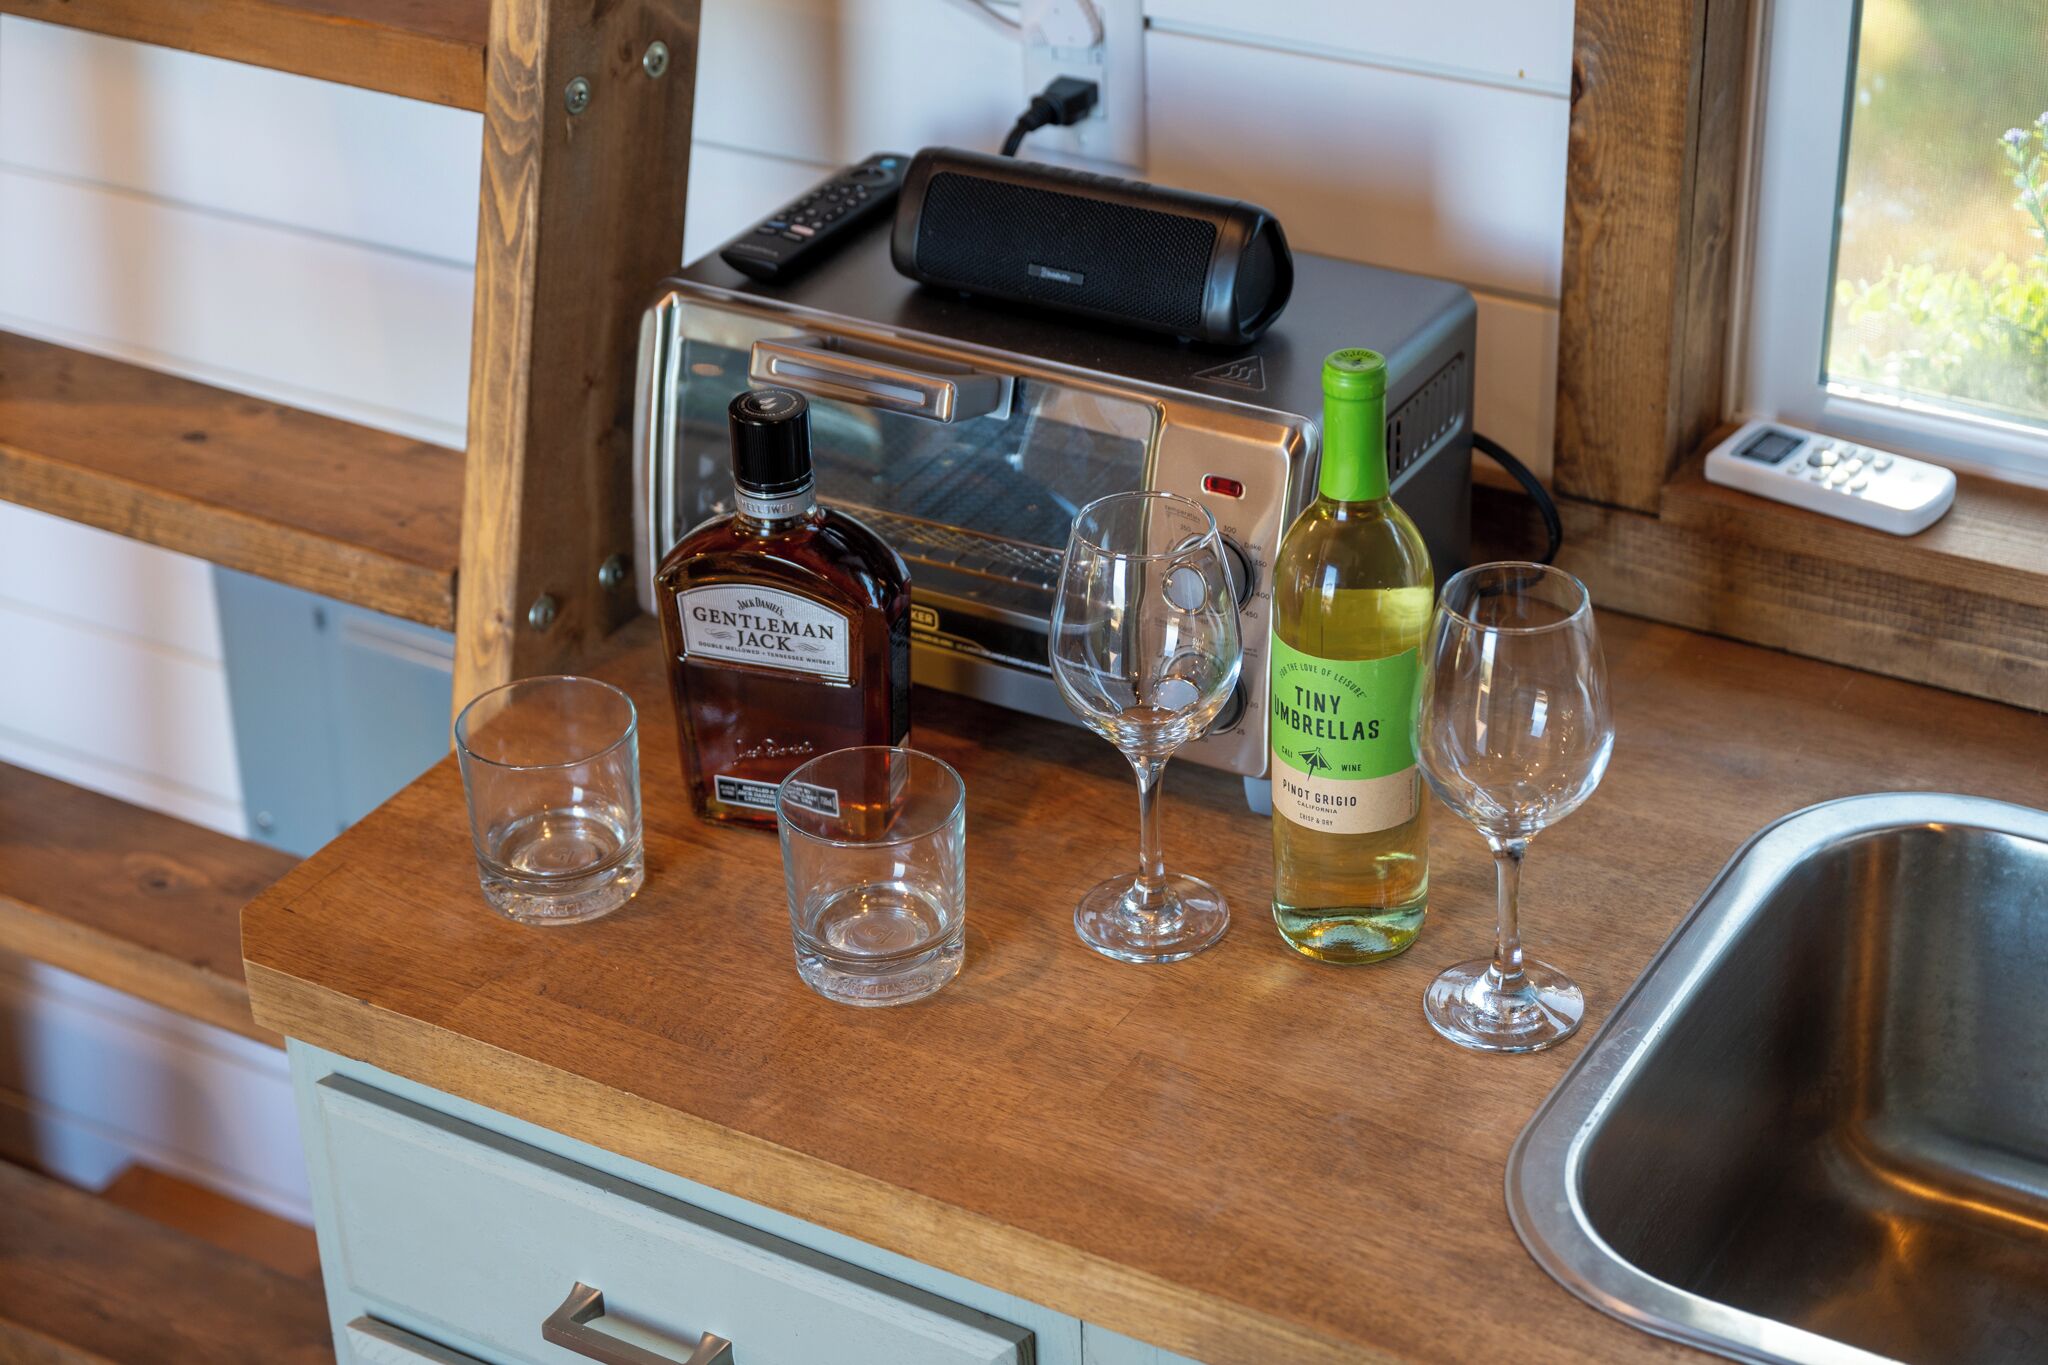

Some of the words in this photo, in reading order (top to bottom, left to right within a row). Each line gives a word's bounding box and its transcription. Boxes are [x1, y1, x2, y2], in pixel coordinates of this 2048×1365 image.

[1223, 525, 1237, 534] 300
[737, 599, 755, 611] JACK
[1255, 592, 1270, 600] 400
[692, 606, 834, 640] GENTLEMAN
[1245, 610, 1258, 619] 450
[737, 629, 793, 652] JACK
[698, 640, 723, 650] DOUBLE
[725, 645, 760, 656] MELLOWED
[767, 651, 804, 662] TENNESSEE
[805, 657, 835, 666] WHISKEY
[1287, 662, 1298, 671] THE
[1300, 663, 1317, 674] LOVE
[1321, 667, 1332, 677] OF
[1334, 673, 1366, 698] LEISURE
[1295, 685, 1341, 715] TINY
[1274, 694, 1379, 741] UMBRELLAS
[1281, 745, 1293, 758] CALI
[1341, 764, 1362, 772] WINE
[1283, 778, 1310, 801] PINOT
[1315, 792, 1357, 807] GRIGIO
[1297, 800, 1338, 815] CALIFORNIA
[1299, 812, 1315, 823] CRISP
[1321, 819, 1333, 827] DRY
